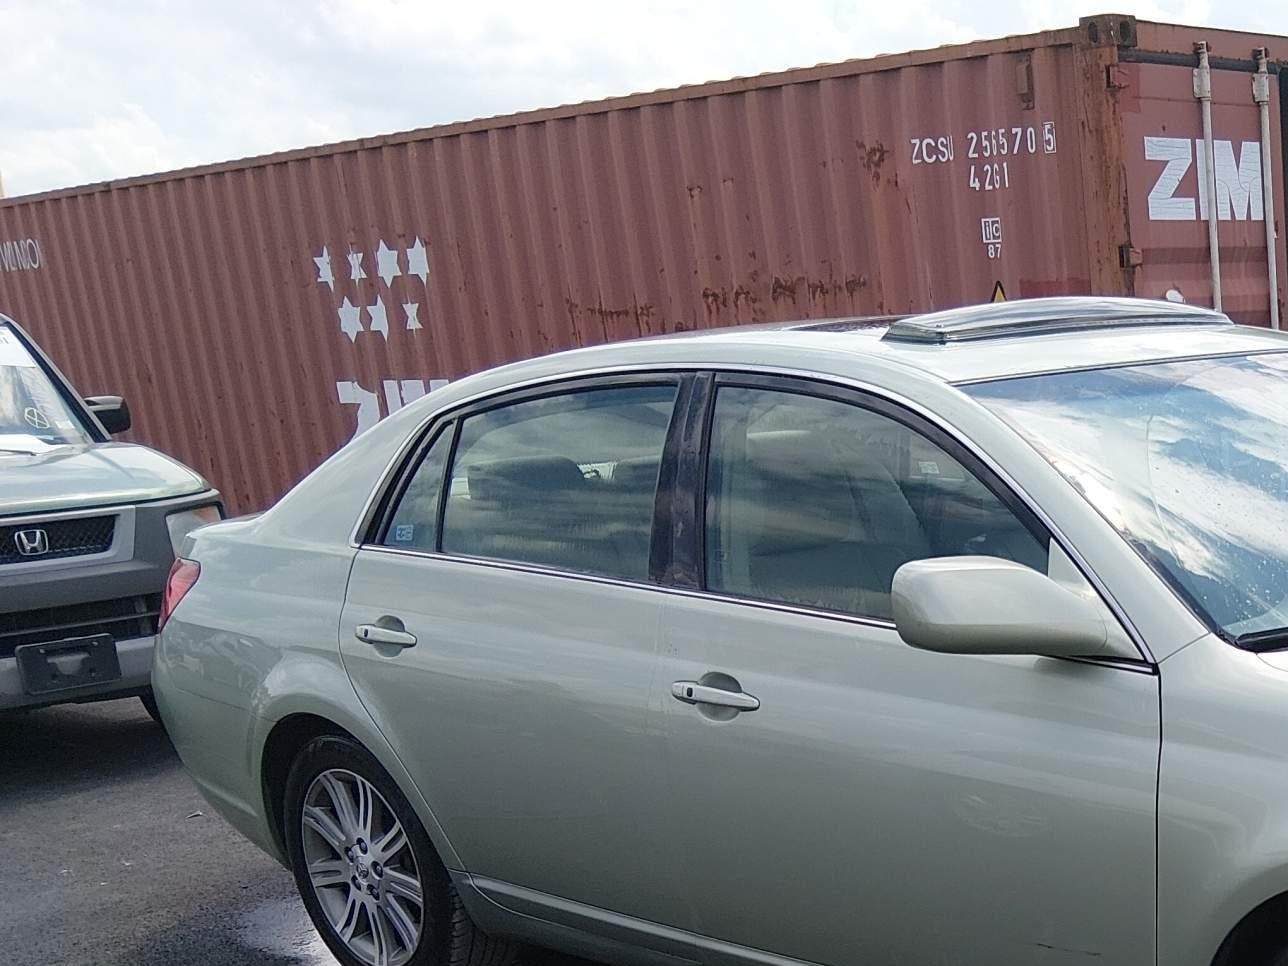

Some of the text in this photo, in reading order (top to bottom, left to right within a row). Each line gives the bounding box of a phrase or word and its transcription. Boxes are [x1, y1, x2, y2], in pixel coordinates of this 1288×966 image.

[911, 123, 1055, 164] ZCSU 256570 5
[969, 162, 1009, 191] 42G1
[1143, 136, 1264, 220] ZIM
[988, 244, 1002, 259] 87
